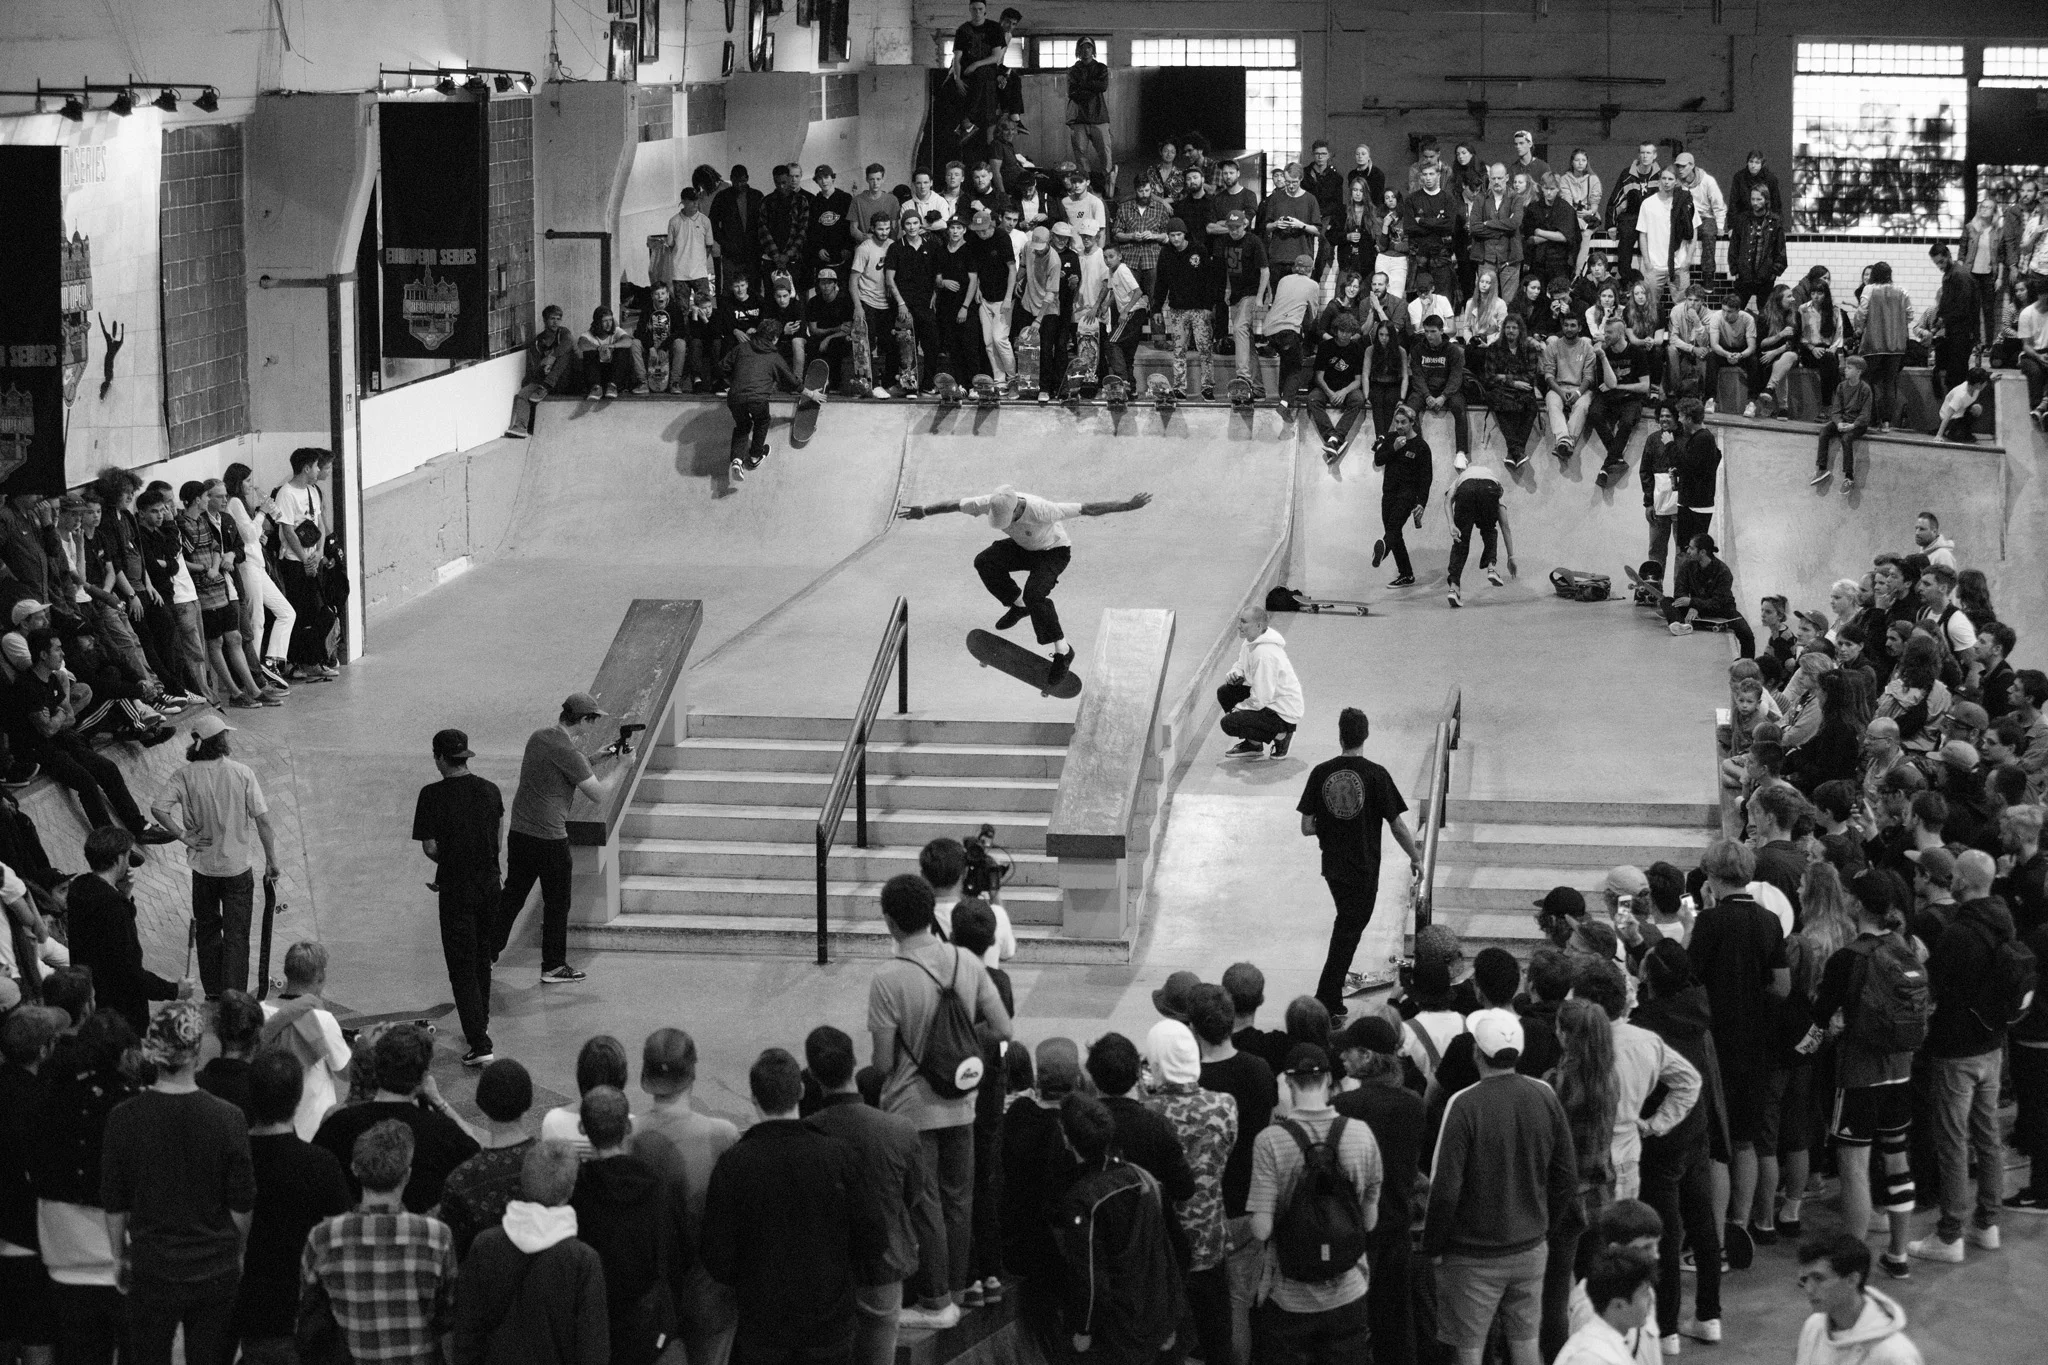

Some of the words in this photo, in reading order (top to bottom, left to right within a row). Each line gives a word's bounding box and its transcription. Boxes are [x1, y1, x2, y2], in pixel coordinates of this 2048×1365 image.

[74, 146, 106, 184] SERIES
[386, 248, 437, 265] EUROPEAN
[440, 248, 476, 266] SERIES
[9, 345, 57, 367] SERIES
